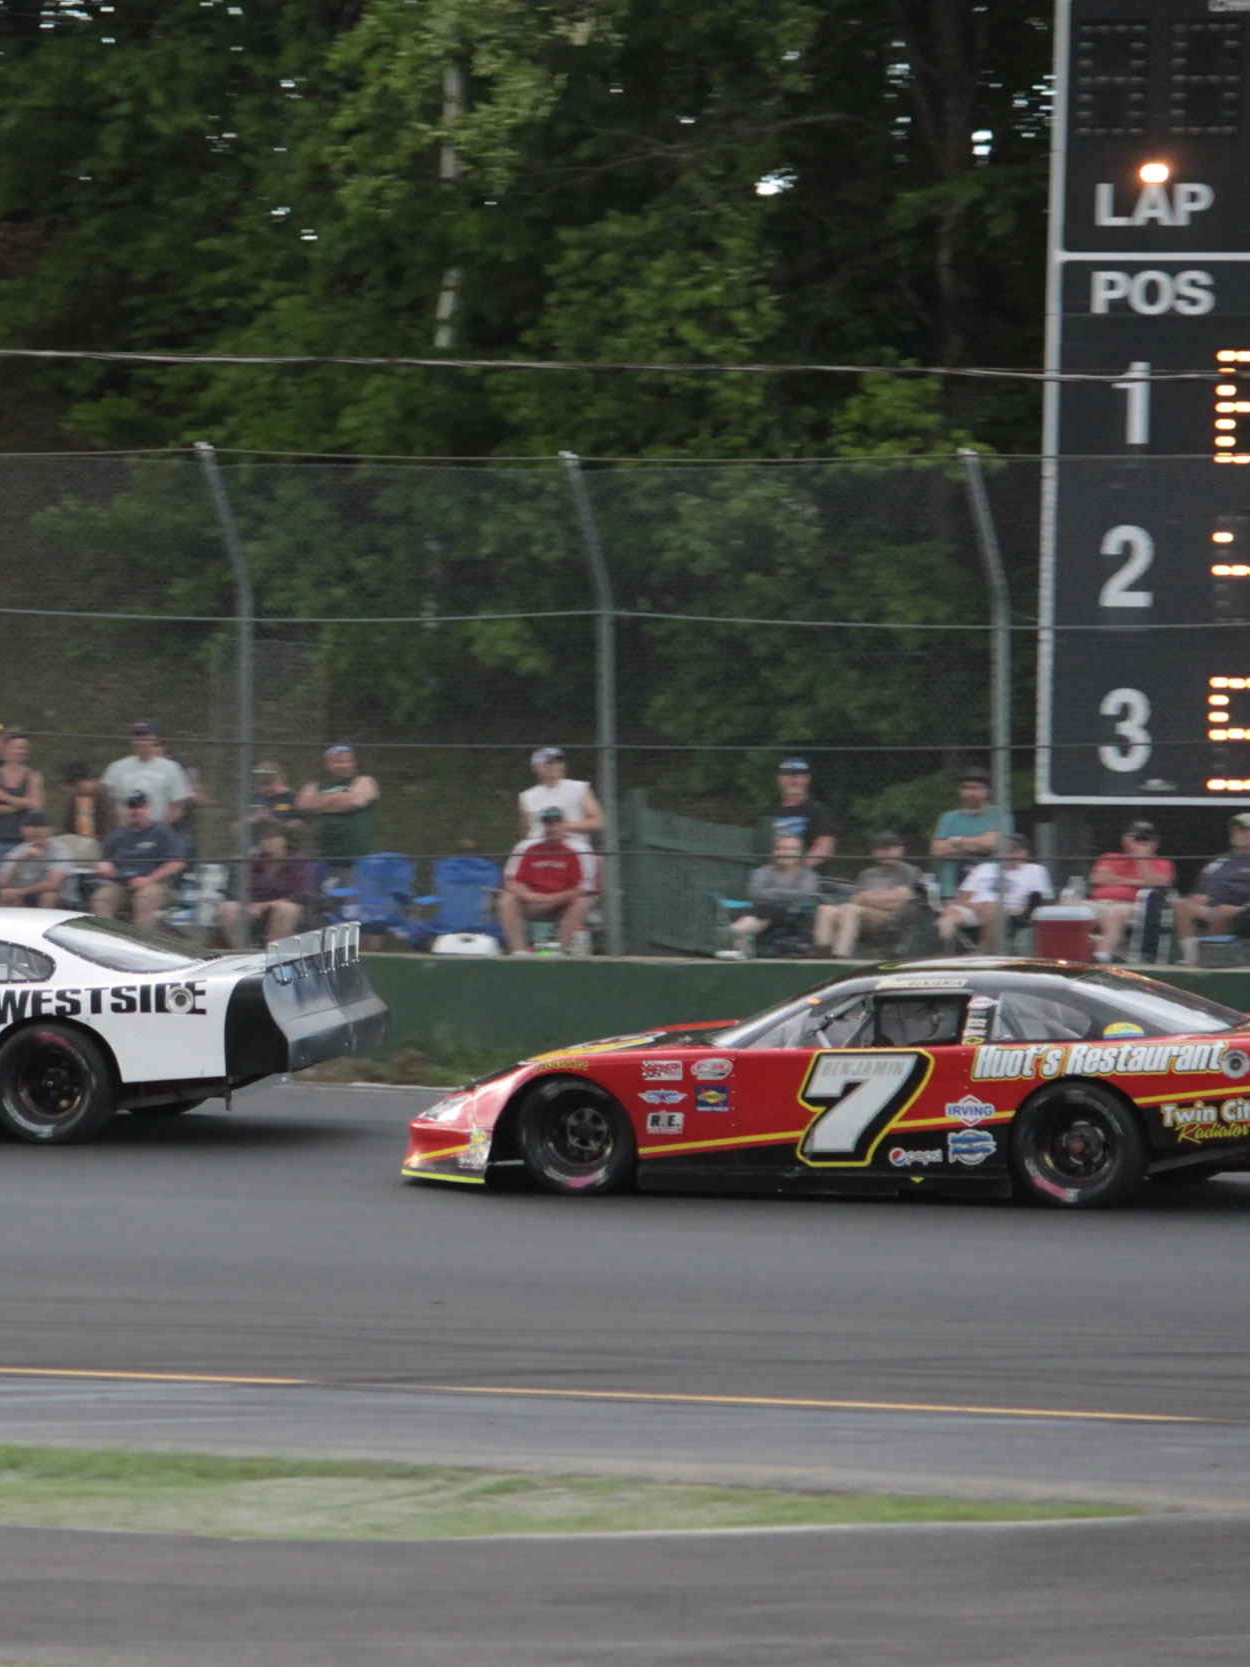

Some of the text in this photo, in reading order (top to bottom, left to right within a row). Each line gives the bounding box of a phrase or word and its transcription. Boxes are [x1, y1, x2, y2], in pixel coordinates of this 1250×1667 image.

[1094, 182, 1216, 226] LAP
[1090, 270, 1216, 315] POS
[1111, 361, 1150, 445] 1
[1098, 524, 1154, 608] 2
[1097, 687, 1151, 773] 3
[821, 1061, 905, 1076] BENJAMIN
[973, 1039, 1229, 1080] Huot's Restaurant
[800, 1051, 929, 1162] 7
[947, 1104, 994, 1117] IRVING
[1161, 1101, 1218, 1127] Twin
[904, 1148, 943, 1166] pepsi
